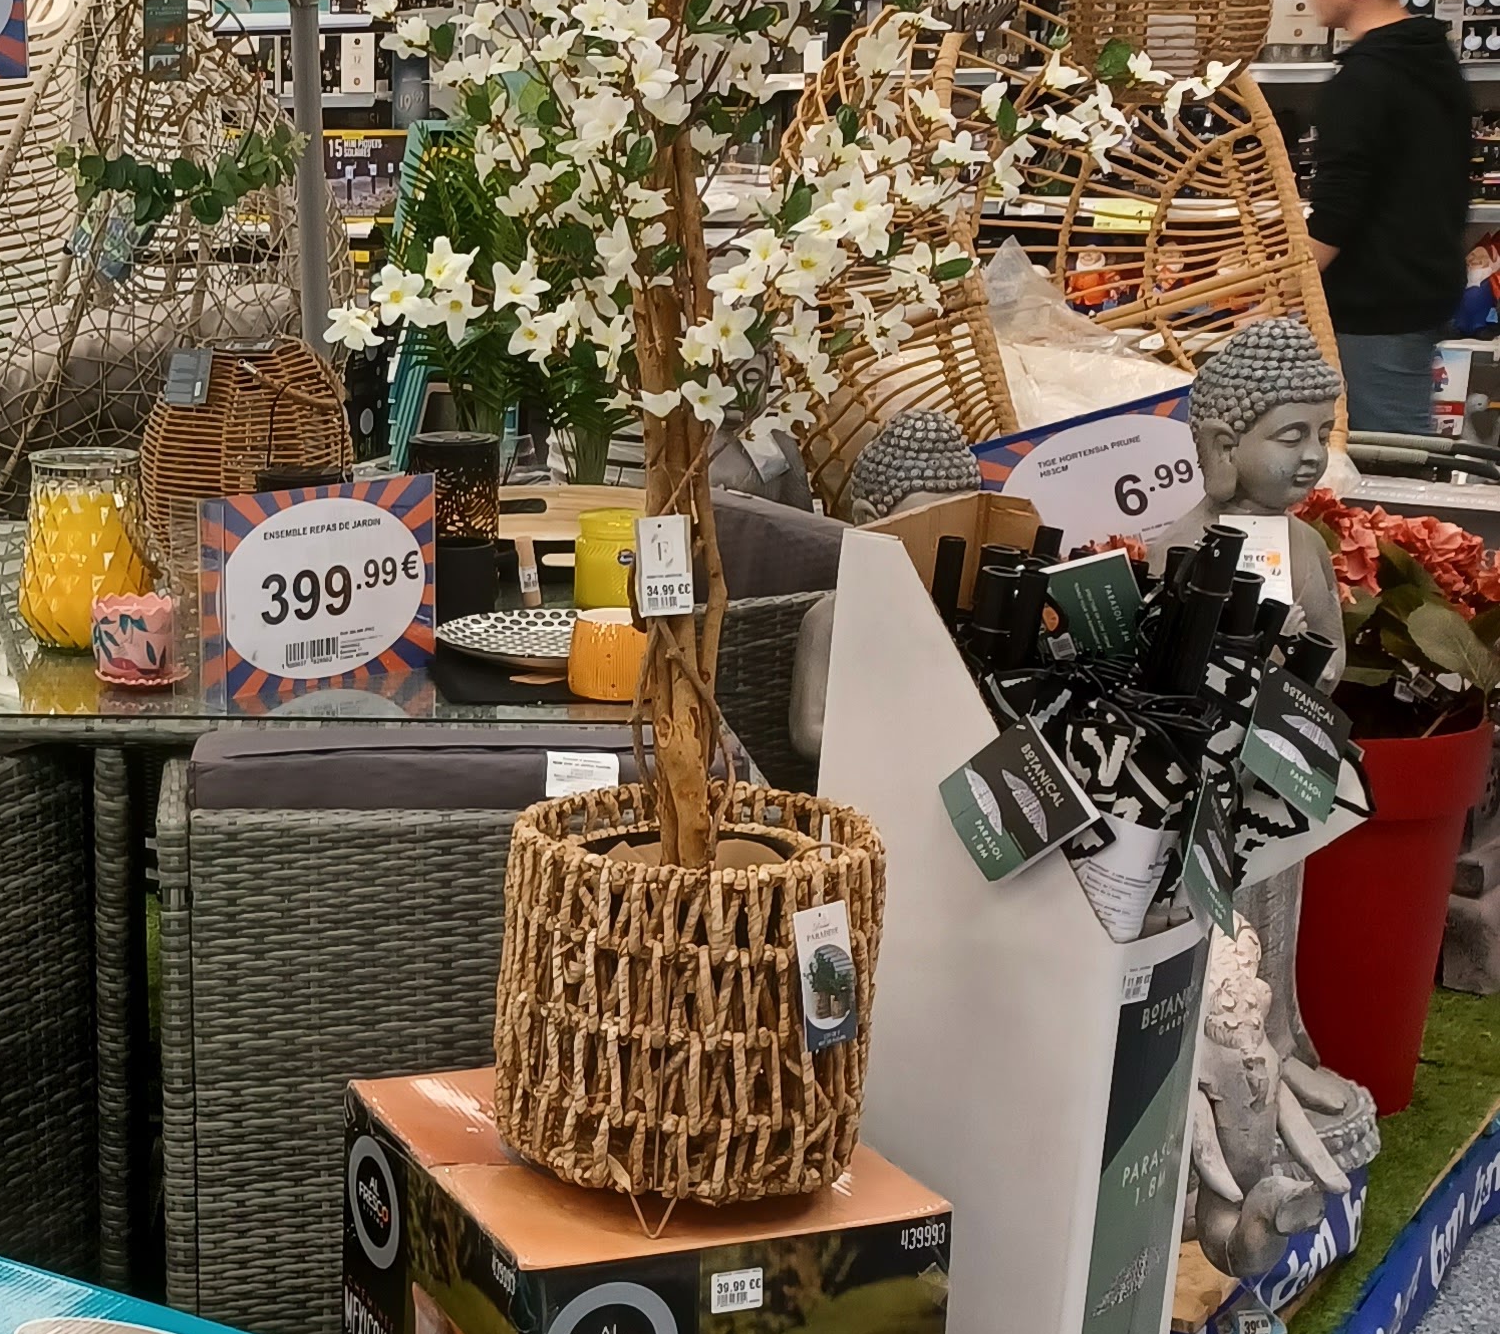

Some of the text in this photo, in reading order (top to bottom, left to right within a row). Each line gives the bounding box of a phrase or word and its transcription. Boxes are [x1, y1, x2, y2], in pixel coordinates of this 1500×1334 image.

[328, 139, 343, 157] 15
[1111, 435, 1141, 450] PRUNE
[1114, 458, 1201, 516] 6.99
[264, 527, 308, 540] ENSEMBLE
[310, 523, 337, 535] REPAS
[352, 518, 381, 530] JARDIN
[647, 584, 674, 596] 34.99
[1283, 681, 1334, 726] BOTANICAL
[1020, 743, 1065, 808] BOTANICAL
[1289, 768, 1322, 798] PARASOL
[974, 819, 1003, 860] PARASOL
[369, 1177, 379, 1195] AL
[359, 1181, 388, 1222] FRESCO
[900, 1223, 946, 1250] 439993
[717, 1279, 745, 1295] 39.99
